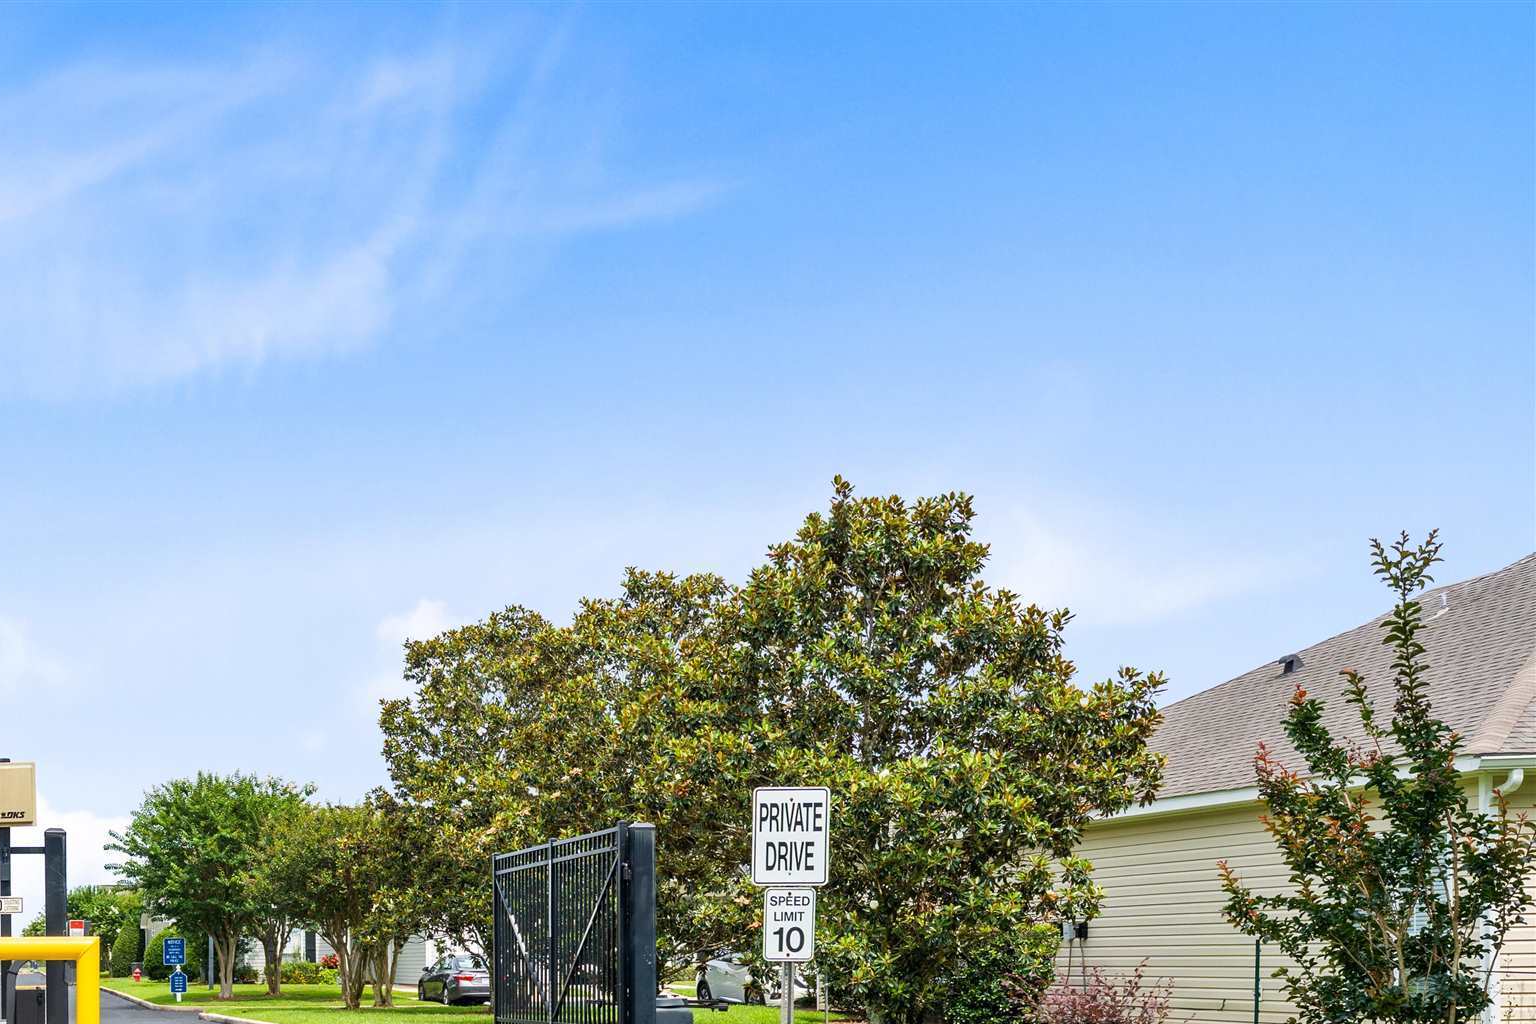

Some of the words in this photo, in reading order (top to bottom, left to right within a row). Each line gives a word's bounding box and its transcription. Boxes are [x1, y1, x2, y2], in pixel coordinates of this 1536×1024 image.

[6, 811, 26, 819] DKS
[759, 802, 823, 833] PRIVATE
[765, 841, 815, 871] DRIVE
[769, 895, 811, 907] SPEED
[773, 911, 805, 922] LIMIT
[773, 926, 805, 953] 10
